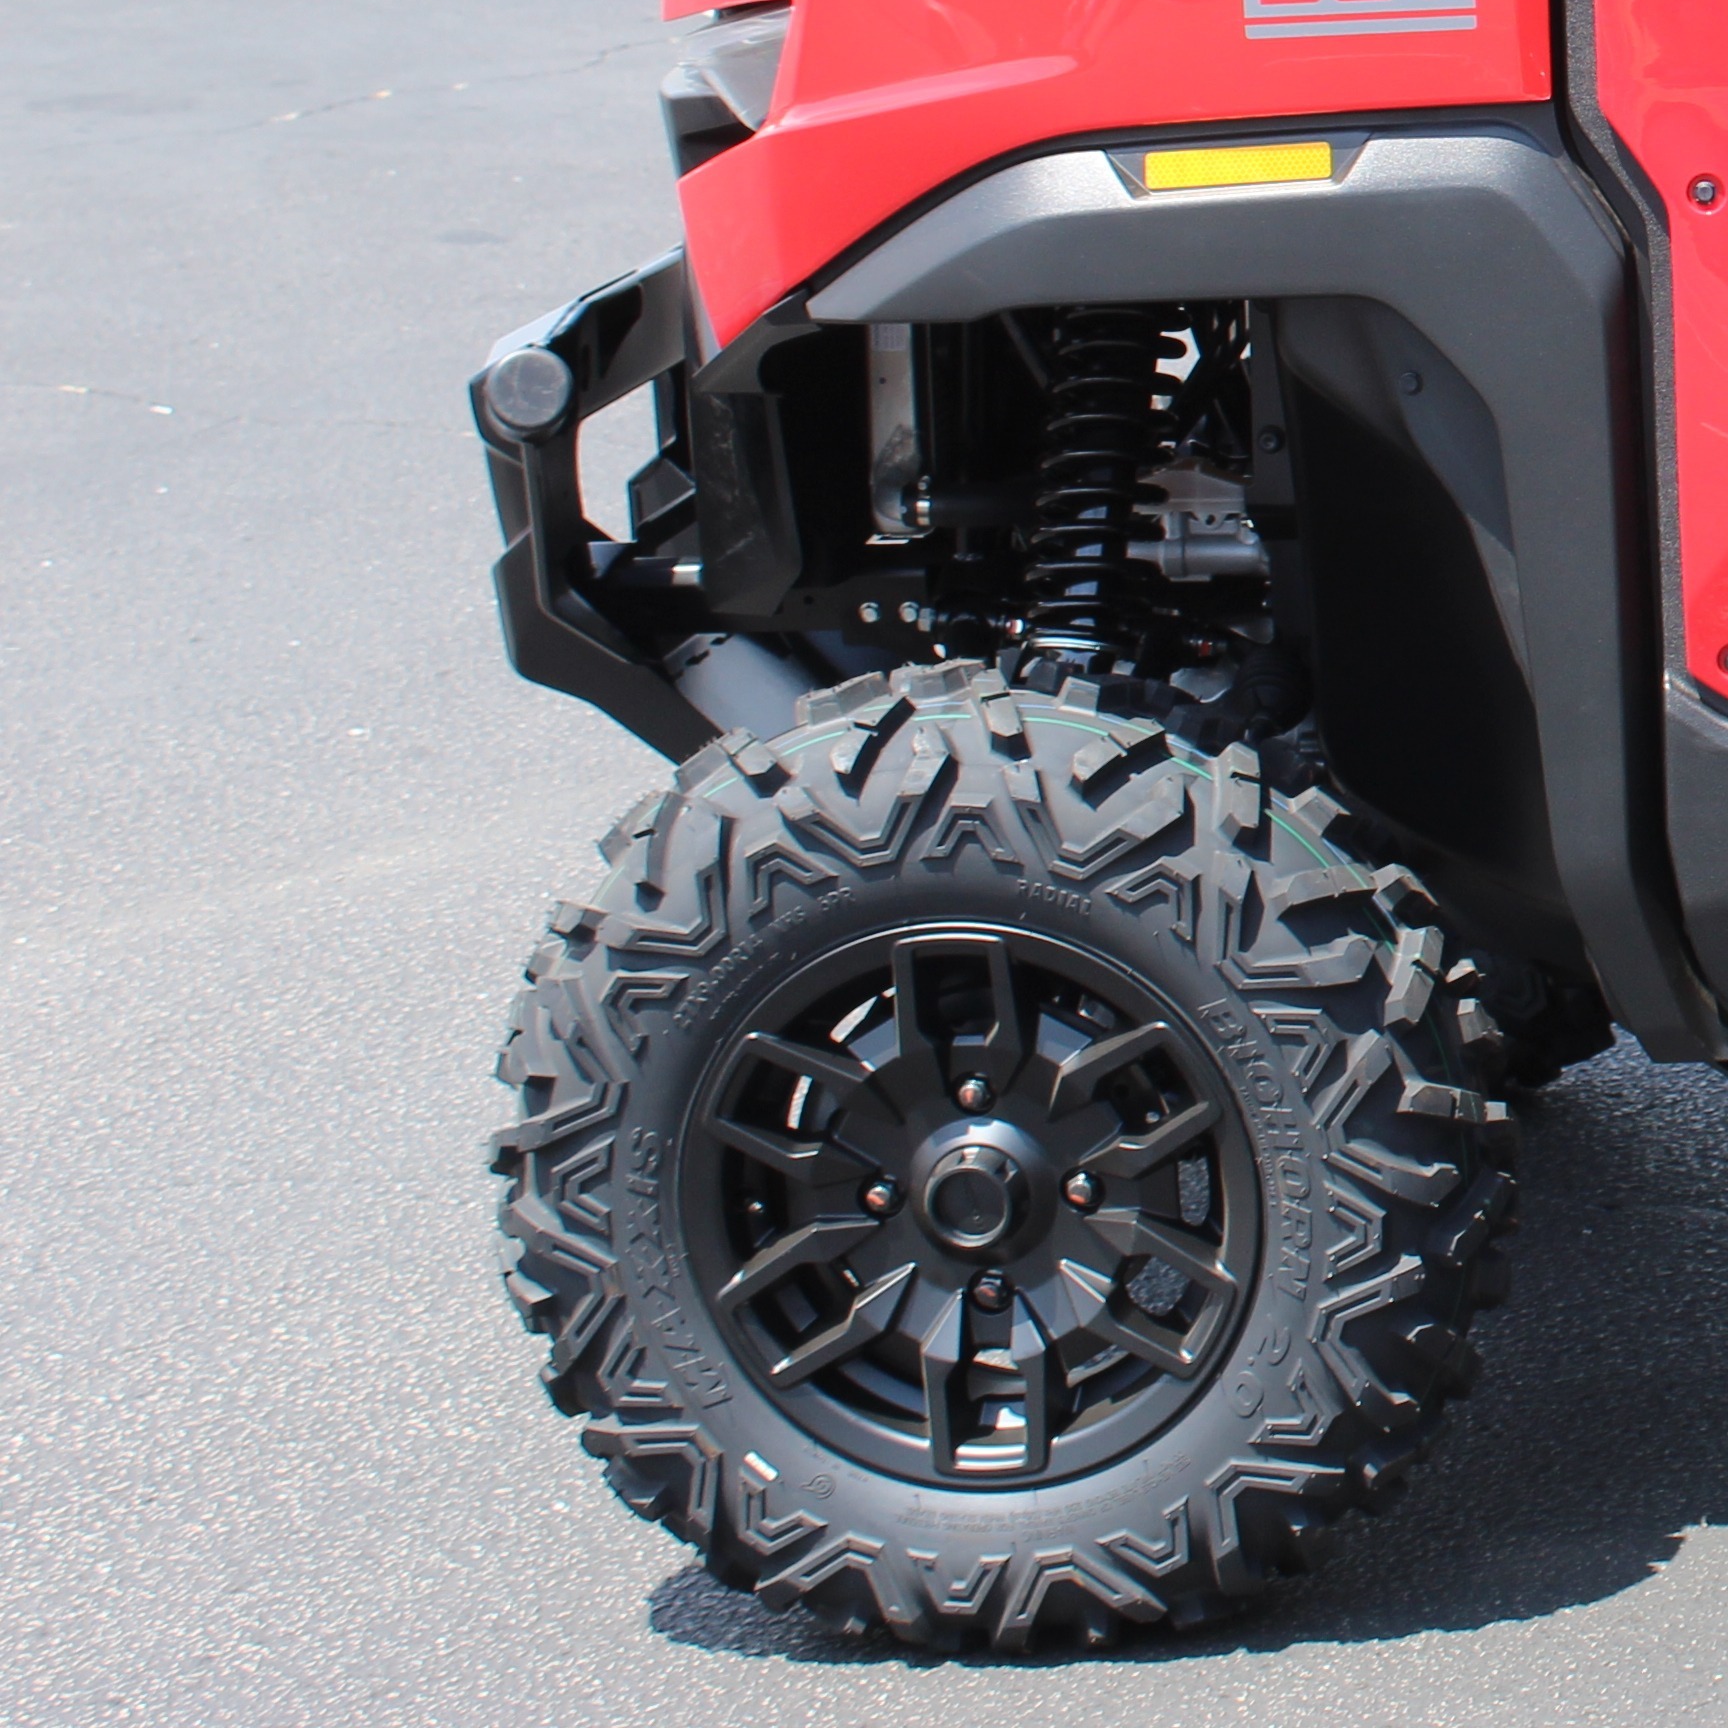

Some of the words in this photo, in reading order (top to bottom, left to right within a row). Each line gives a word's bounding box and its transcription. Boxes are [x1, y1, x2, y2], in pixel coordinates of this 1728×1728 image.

[1016, 878, 1092, 916] RADIAL
[1197, 998, 1313, 1301] BIGHORN
[625, 1125, 733, 1410] MAXXIS
[1222, 1313, 1292, 1419] 2.0
